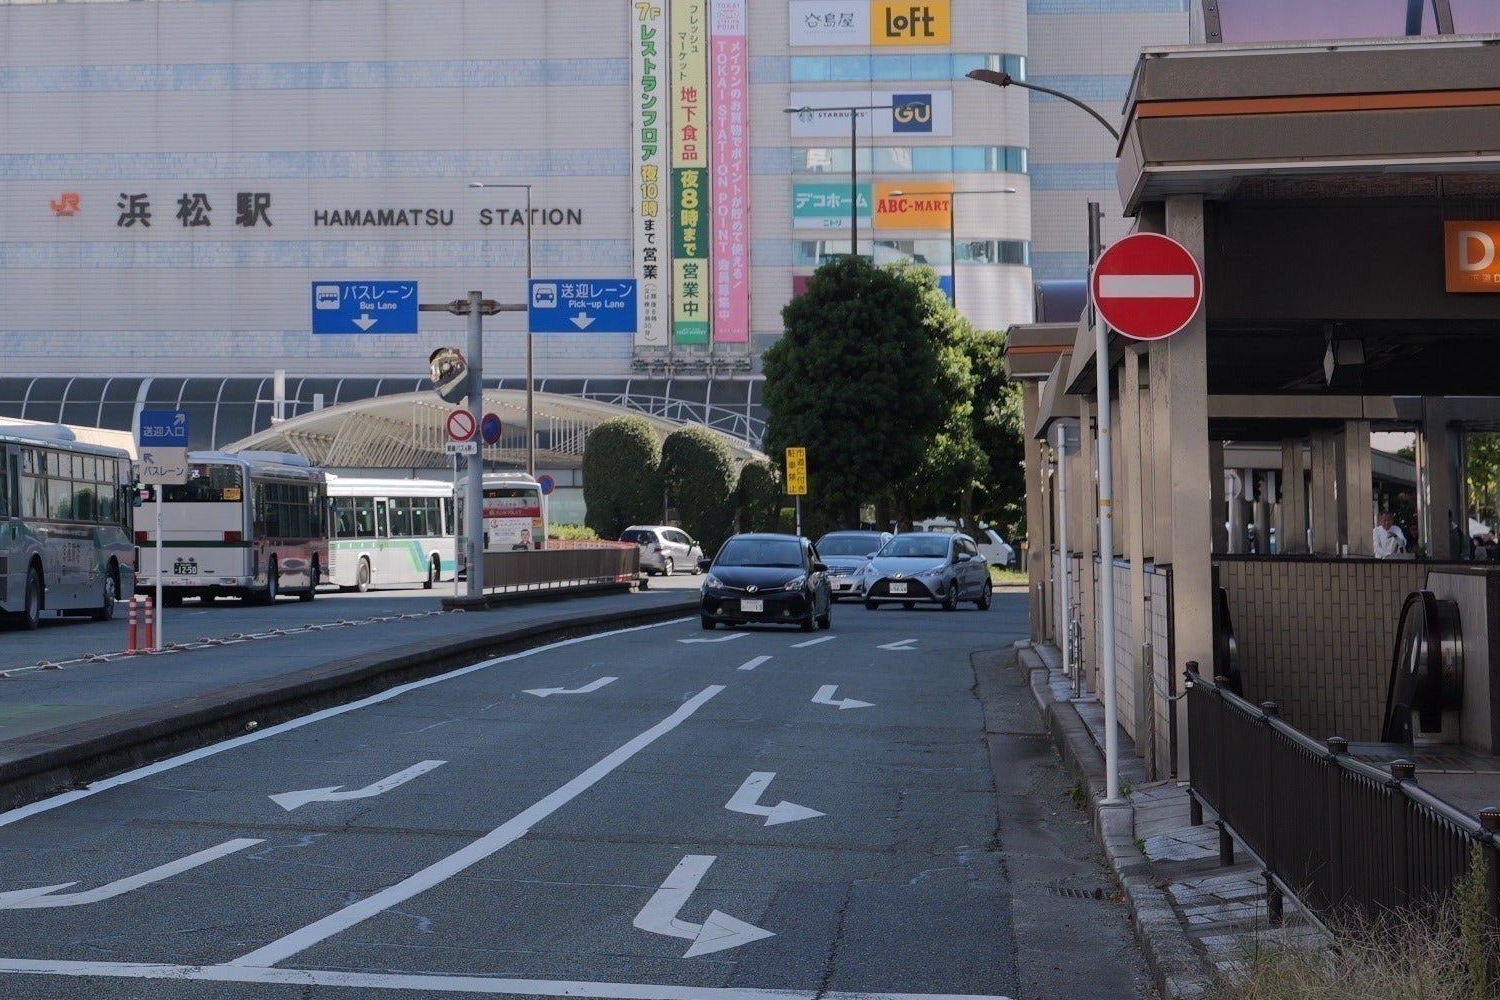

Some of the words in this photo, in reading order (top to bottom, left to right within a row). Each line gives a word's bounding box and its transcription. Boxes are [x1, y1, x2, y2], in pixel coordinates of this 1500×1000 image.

[634, 2, 660, 21] 7F
[641, 24, 657, 161] レストランフロア
[818, 111, 866, 119] STARBUKS
[894, 104, 932, 123] GU
[681, 86, 698, 161] 地下食品
[50, 192, 81, 211] JR
[795, 192, 868, 209] デコホーム
[877, 198, 950, 213] ABC-MART
[116, 192, 273, 228] 浜松駅
[314, 207, 454, 227] HAMAMATSU
[480, 207, 583, 227] STATION
[343, 285, 414, 300] バスレーン
[560, 283, 633, 299] 送迎レーン
[683, 262, 699, 318] 営業中
[360, 301, 375, 310] Bus
[377, 301, 398, 310] Lane
[568, 300, 603, 310] Pick-up
[605, 299, 625, 309] Lane
[143, 426, 185, 437] 送迎入口
[143, 466, 184, 477] バスレーン
